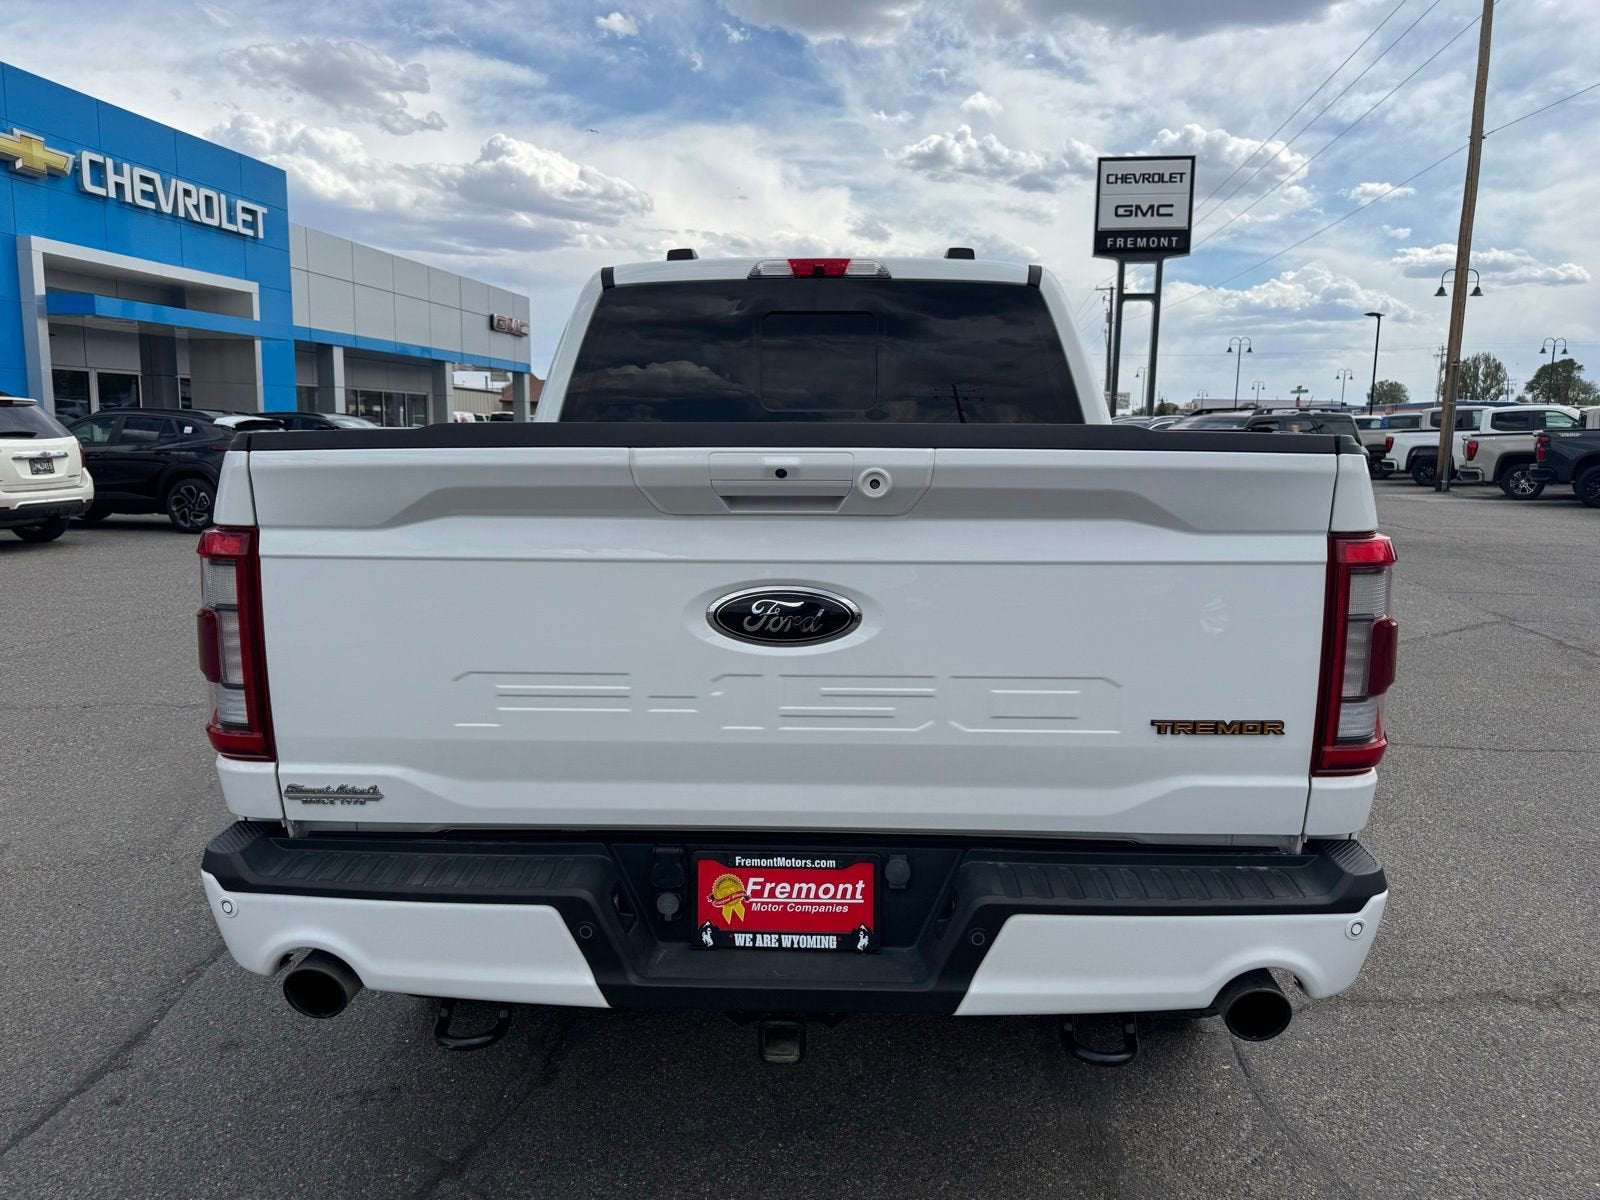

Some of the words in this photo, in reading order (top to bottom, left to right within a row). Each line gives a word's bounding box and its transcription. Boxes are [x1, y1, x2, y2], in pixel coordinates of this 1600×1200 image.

[1106, 172, 1186, 184] CHEVROLET
[80, 150, 268, 239] CHEVROLET
[1114, 204, 1174, 217] GMC
[1107, 237, 1178, 248] FREMONT
[743, 600, 824, 633] Ford
[1151, 719, 1285, 735] TREMOR
[735, 856, 836, 868] FremontMotors.com
[747, 877, 865, 899] Fremont
[751, 902, 784, 912] Motor
[787, 903, 849, 914] Companies
[734, 933, 753, 947] WE
[756, 934, 779, 948] ARE
[781, 935, 837, 949] WYOMING
